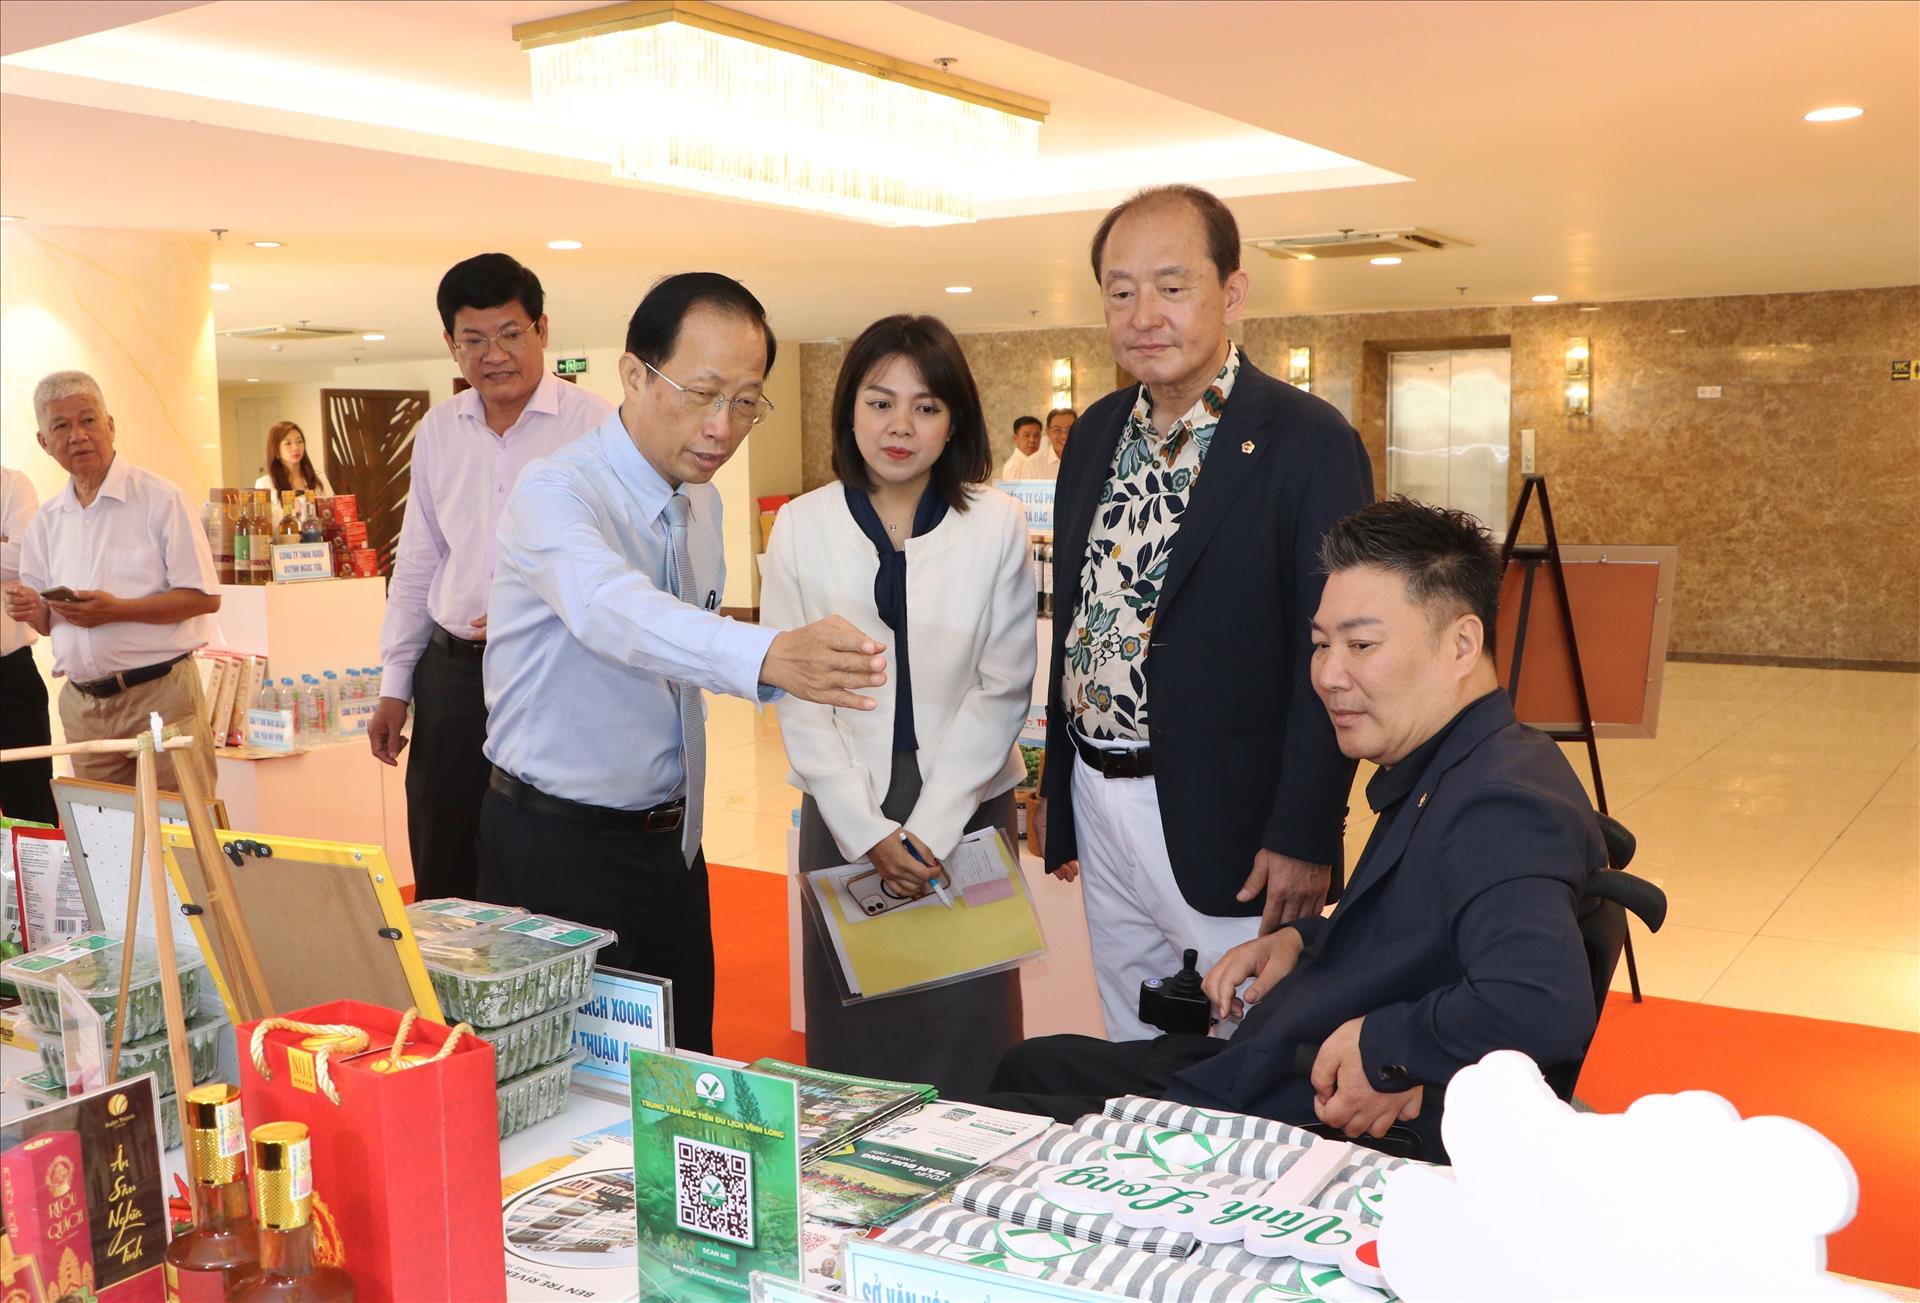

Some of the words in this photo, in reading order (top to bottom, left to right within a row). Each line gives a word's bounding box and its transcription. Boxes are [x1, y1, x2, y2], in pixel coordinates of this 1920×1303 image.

[1036, 718, 1048, 728] TR
[611, 998, 653, 1030] XOONG
[580, 1031, 619, 1066] THUẬN
[641, 1099, 665, 1113] TRUNG
[666, 1104, 681, 1116] TÂM
[715, 1116, 726, 1125] DU
[727, 1119, 744, 1129] LỊCH
[744, 1122, 763, 1135] VĨNH
[764, 1127, 785, 1139] LONG
[860, 1153, 917, 1169] BUILDING
[914, 1171, 946, 1182] TOUR
[917, 1165, 952, 1178] TEAM
[1054, 1165, 1210, 1215] Long
[1209, 1200, 1352, 1246] Vĩnh
[702, 1246, 719, 1257] SCAN
[720, 1251, 731, 1261] ME
[539, 1279, 564, 1291] TRE
[565, 1286, 596, 1298] BEN
